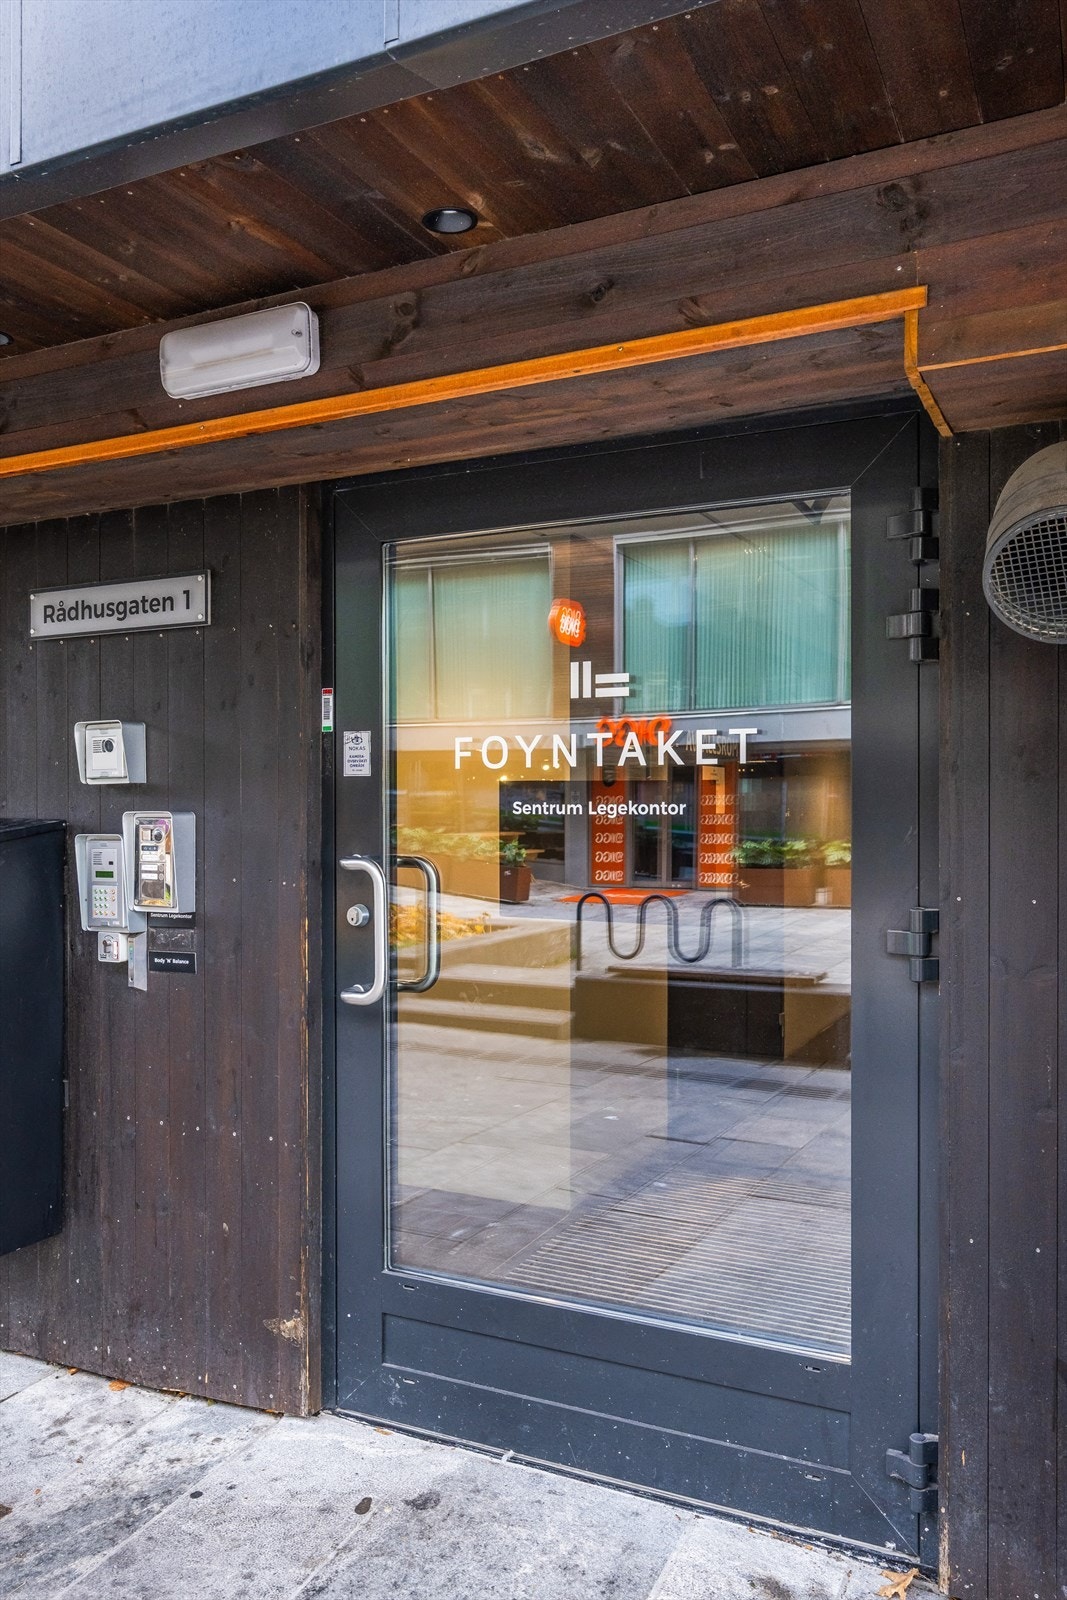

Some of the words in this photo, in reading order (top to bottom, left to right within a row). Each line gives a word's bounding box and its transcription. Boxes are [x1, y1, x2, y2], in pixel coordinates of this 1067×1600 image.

[43, 595, 174, 624] Rådhusgaten
[182, 589, 191, 610] 1
[454, 727, 758, 770] FOYNTAKET
[512, 801, 584, 816] Sentrum
[588, 800, 687, 819] Legekontor
